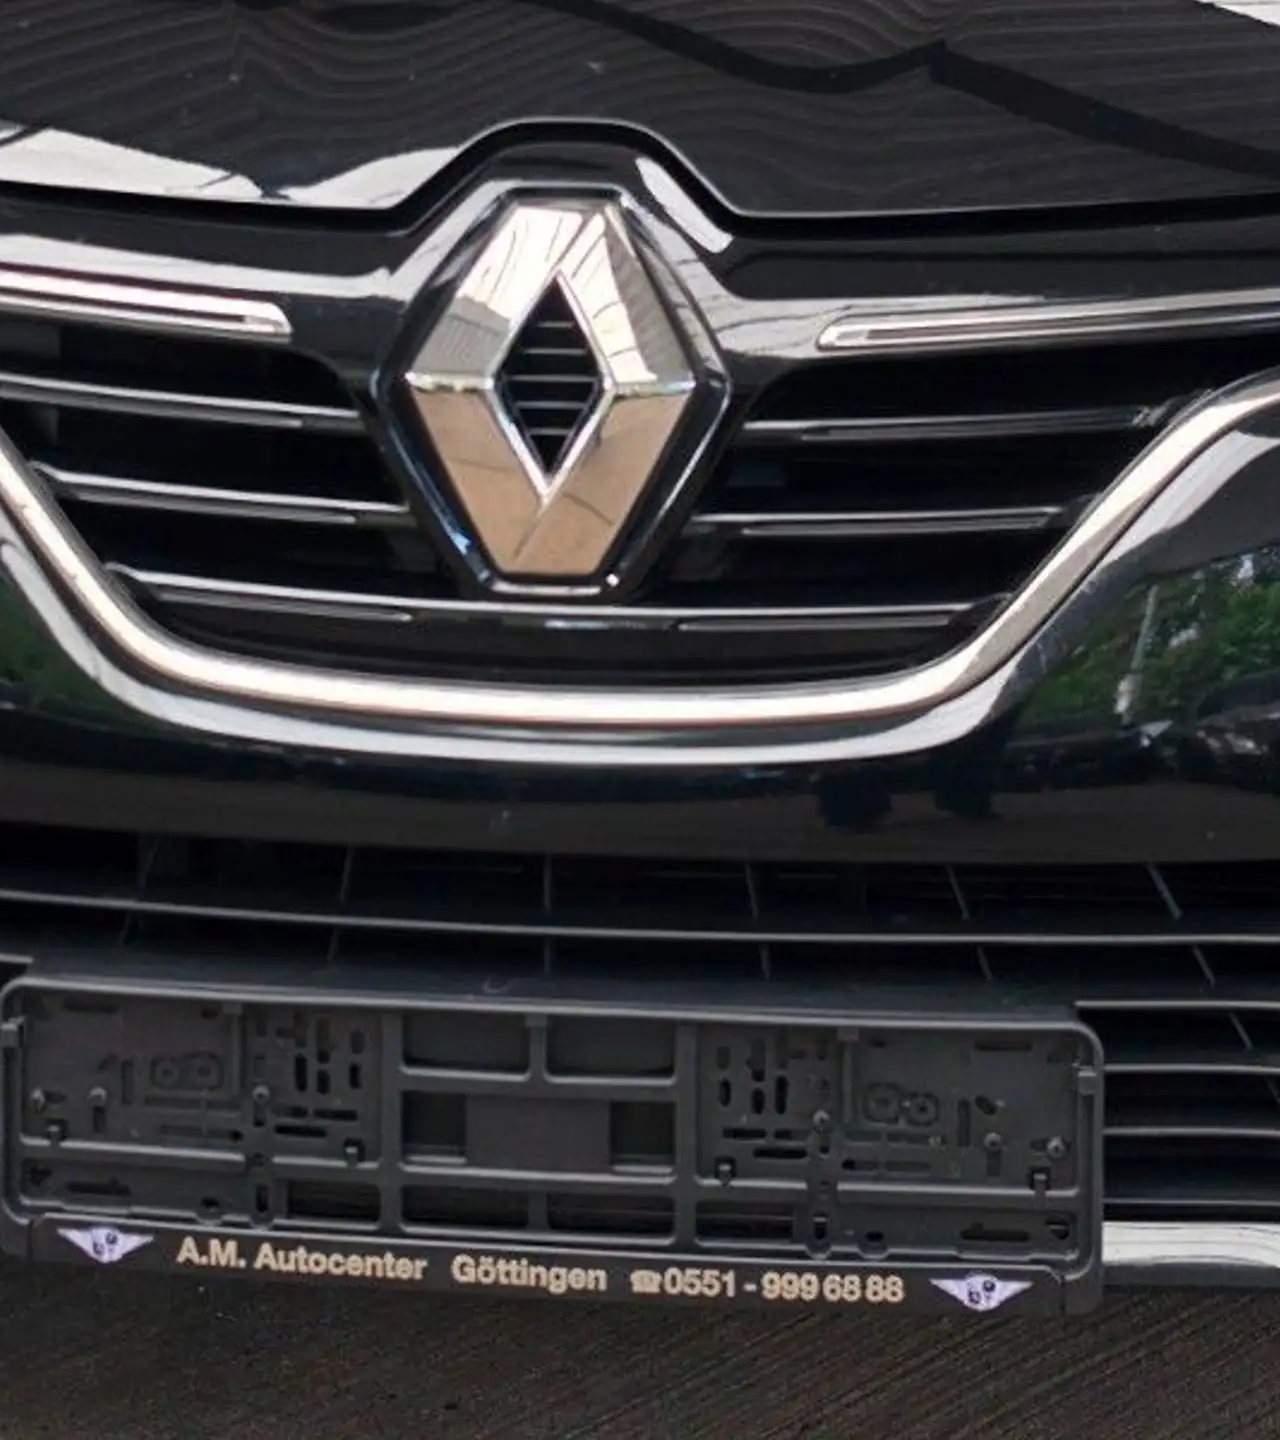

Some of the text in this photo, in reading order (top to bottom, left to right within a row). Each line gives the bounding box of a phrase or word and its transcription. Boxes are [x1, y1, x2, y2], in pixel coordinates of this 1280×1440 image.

[176, 1236, 246, 1268] A.M.
[254, 1242, 427, 1281] Autocenter
[450, 1253, 608, 1293] Göttingen
